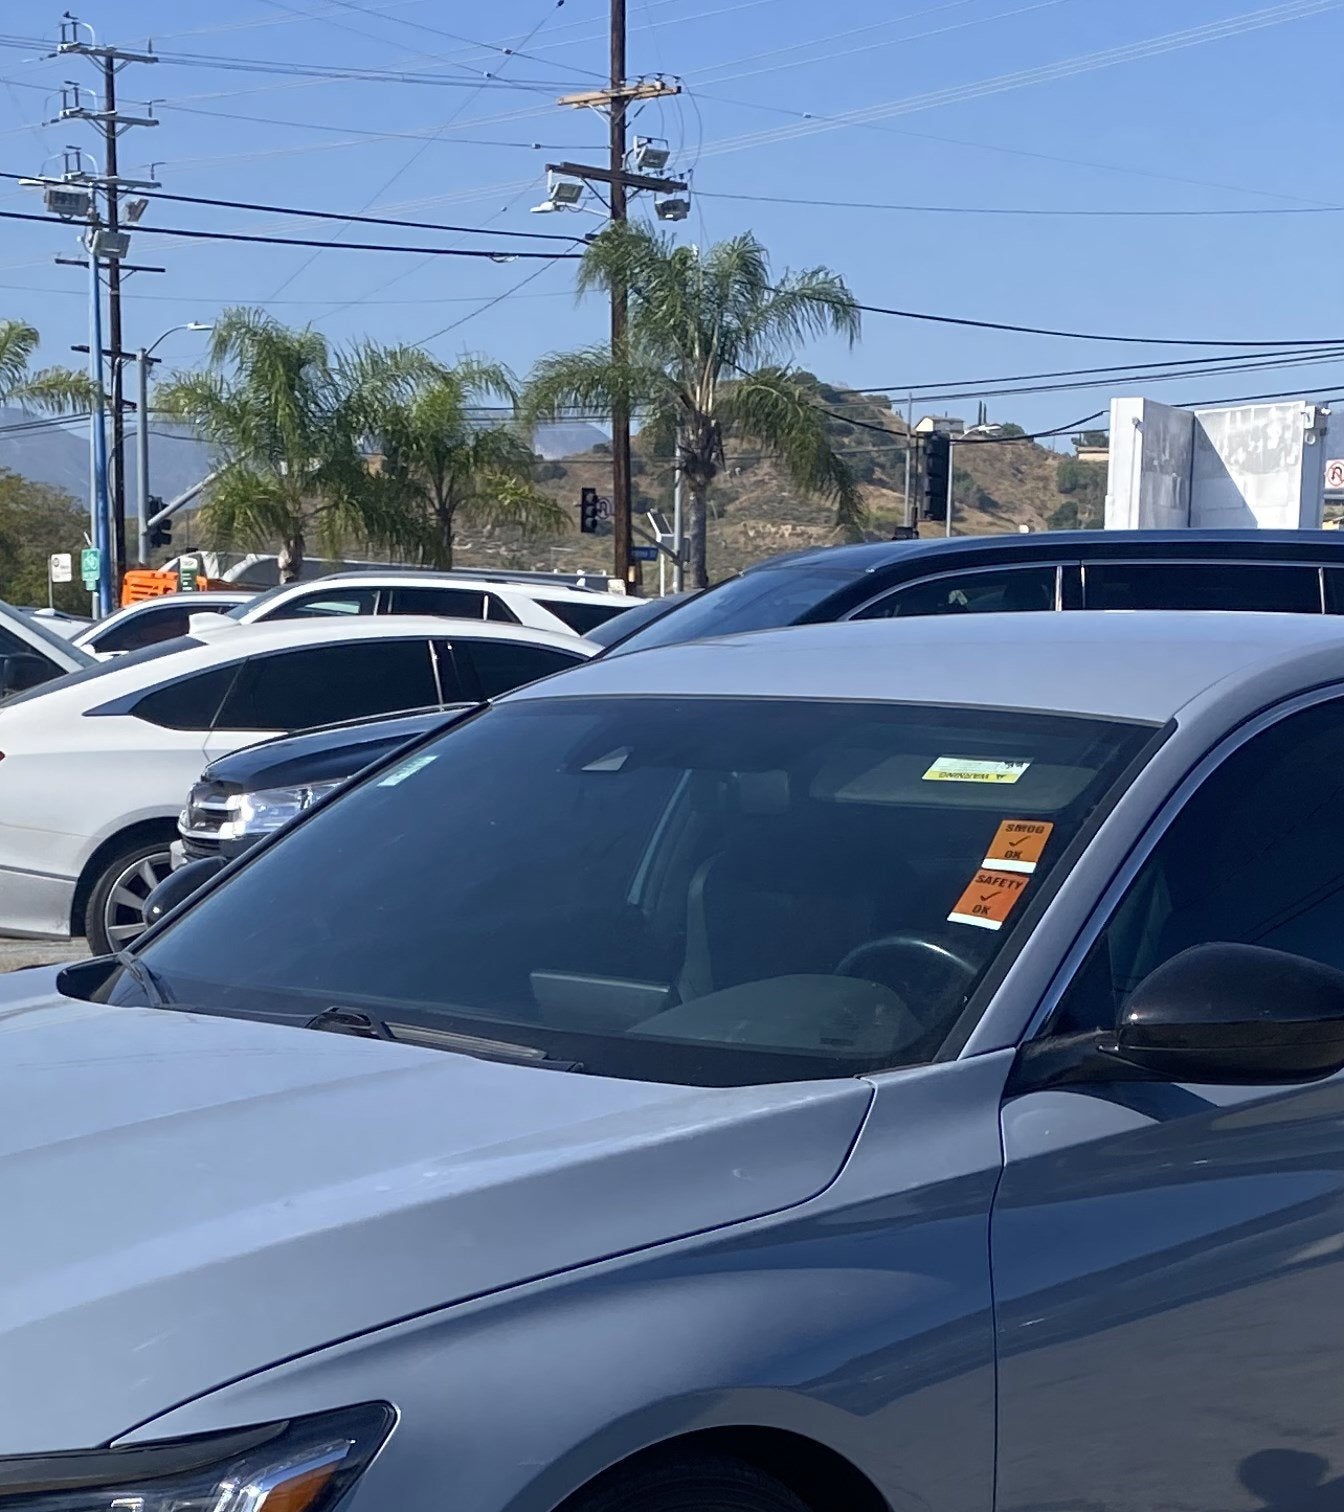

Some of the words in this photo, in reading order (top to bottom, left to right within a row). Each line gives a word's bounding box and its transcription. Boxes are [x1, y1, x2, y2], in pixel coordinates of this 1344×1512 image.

[1005, 824, 1045, 834] SMOG
[1004, 850, 1023, 859] OK
[975, 874, 1023, 890] SAFETY
[972, 904, 991, 915] OK
